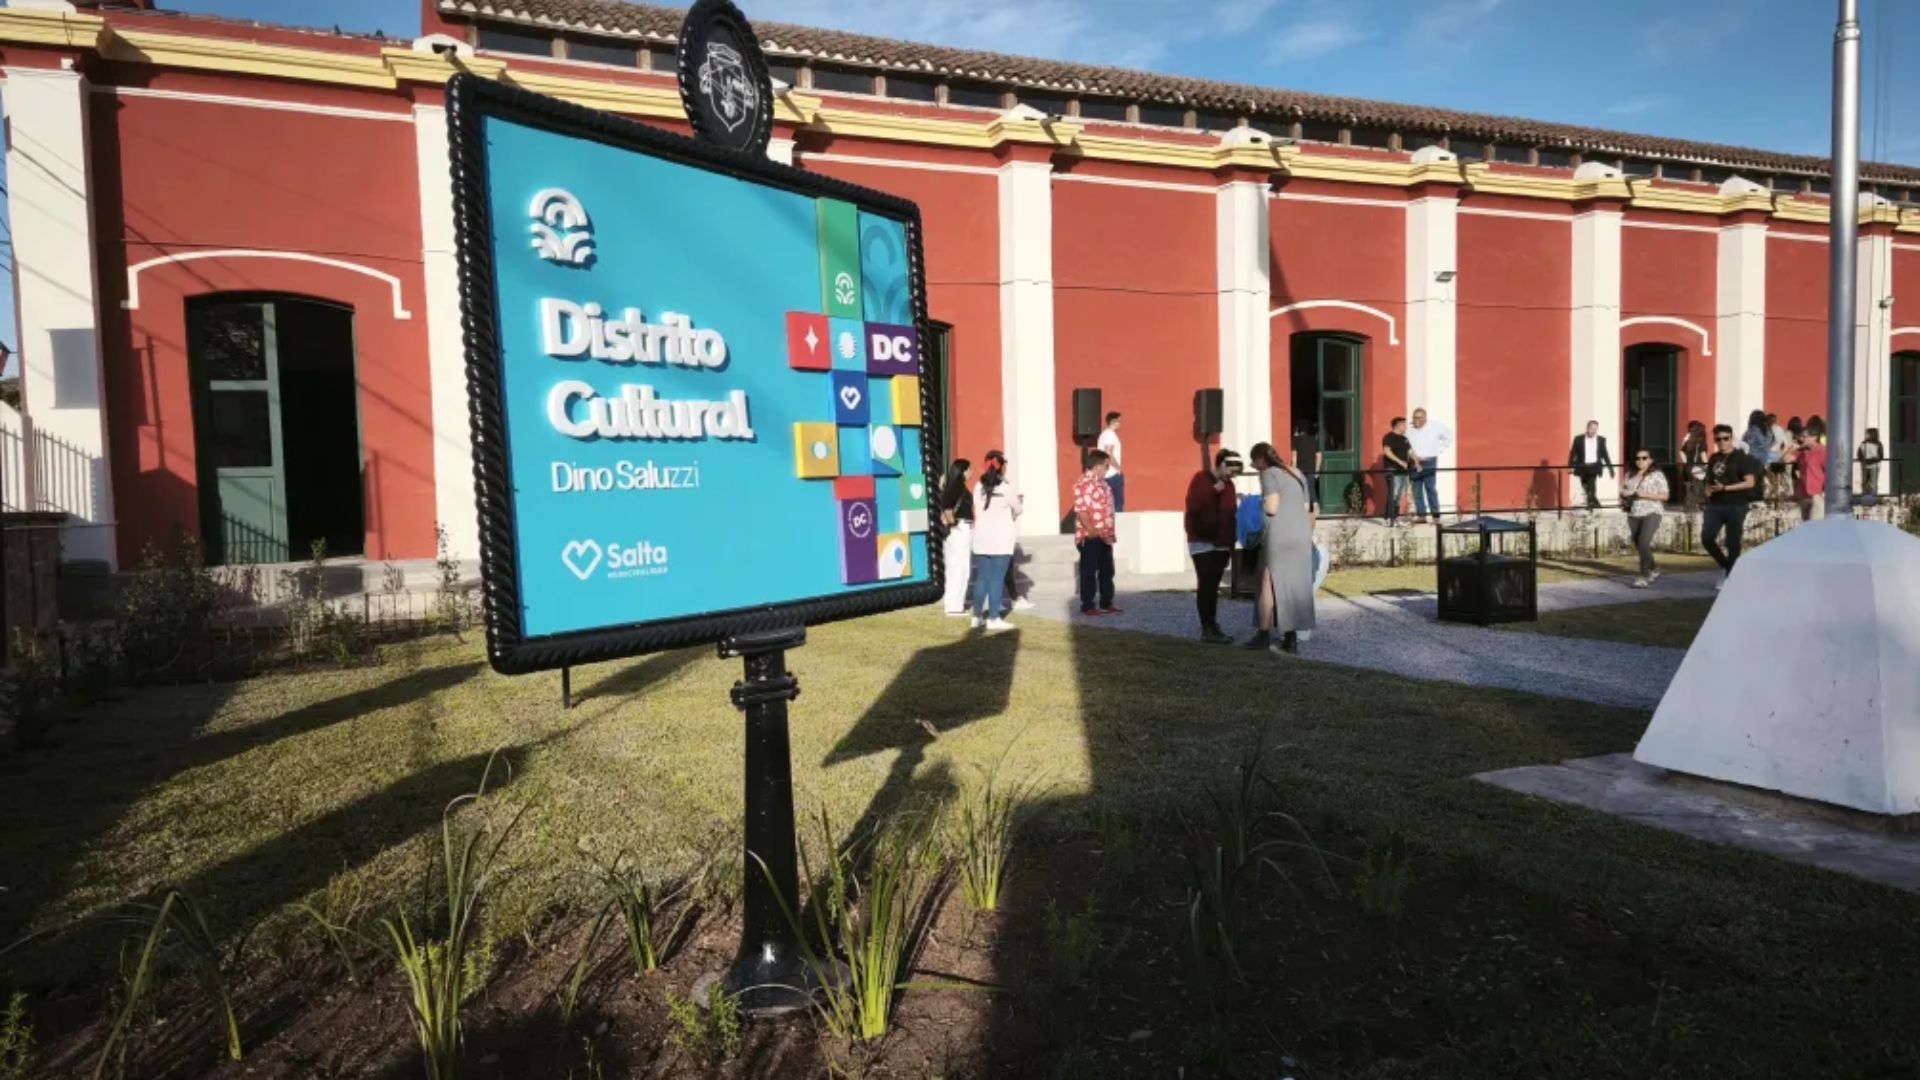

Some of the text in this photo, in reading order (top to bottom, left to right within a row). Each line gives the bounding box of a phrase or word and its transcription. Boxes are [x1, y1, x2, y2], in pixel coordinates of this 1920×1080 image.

[540, 297, 727, 369] Distrito
[871, 333, 912, 362] DC
[548, 379, 754, 439] Cultural
[551, 460, 700, 492] Dino Saluzzi
[853, 513, 867, 528] DC
[607, 542, 668, 569] Salta
